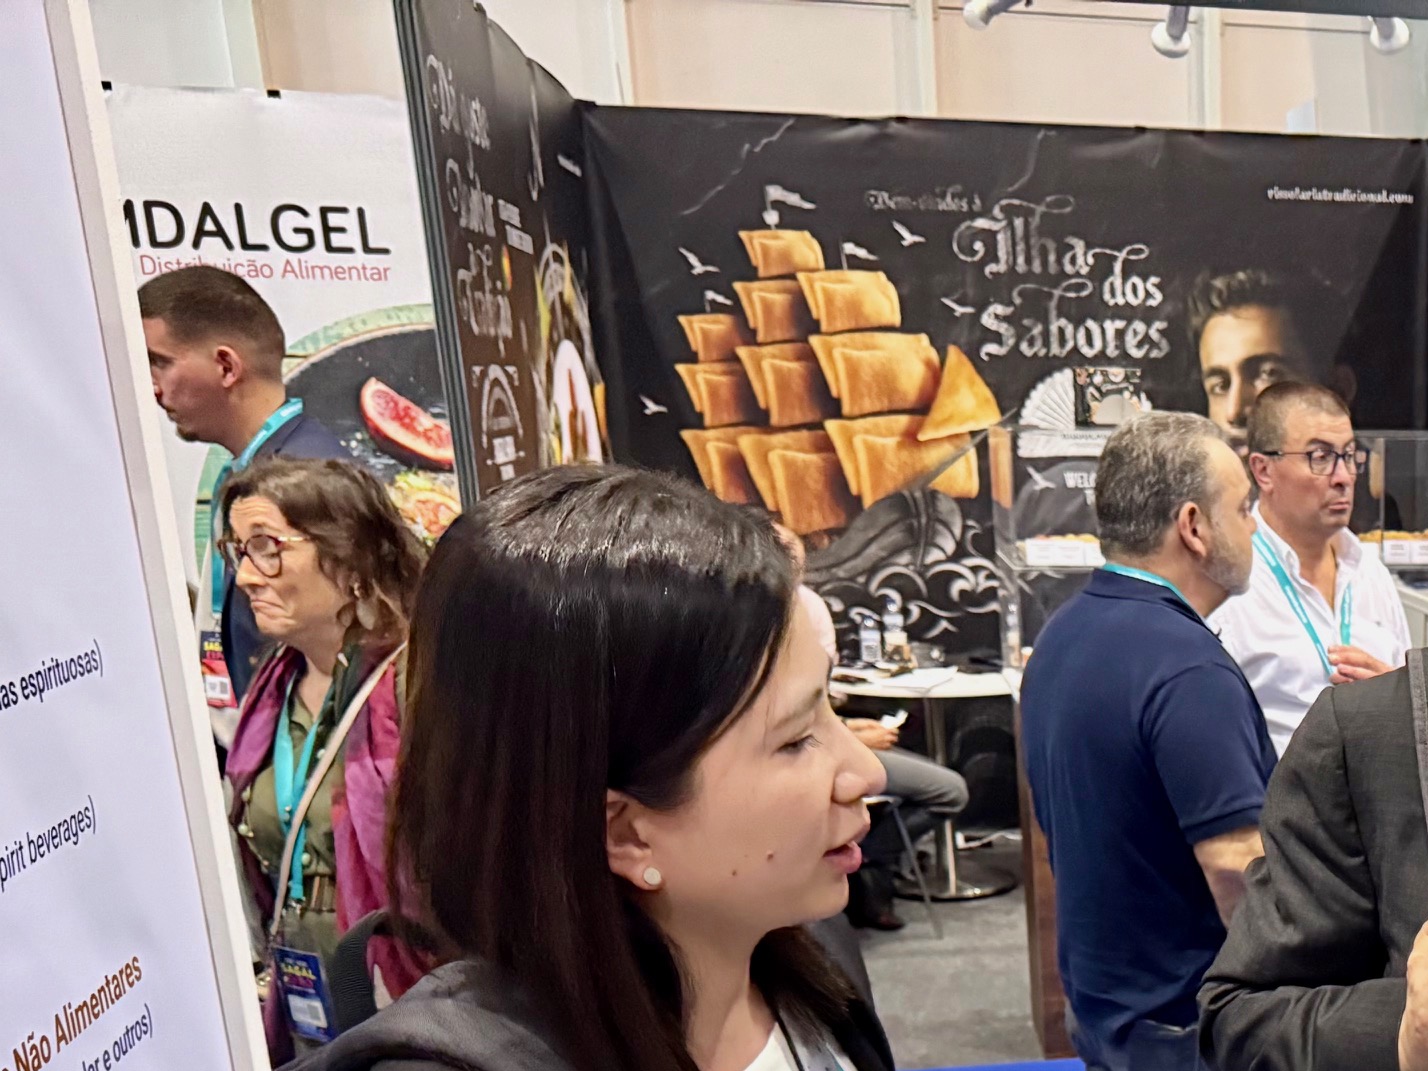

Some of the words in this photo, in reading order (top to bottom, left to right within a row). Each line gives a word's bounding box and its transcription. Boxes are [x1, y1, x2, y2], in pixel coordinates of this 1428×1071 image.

[281, 257, 391, 282] Alimentar
[952, 195, 1094, 279] Ilha
[1088, 244, 1165, 308] dos
[979, 278, 1171, 361] Sabores
[0, 680, 18, 712] as
[20, 637, 104, 704] espirituosas)
[27, 793, 97, 865] beverages)
[54, 955, 143, 1054] Alimentares
[103, 1048, 112, 1071] e
[112, 1002, 154, 1062] outros)
